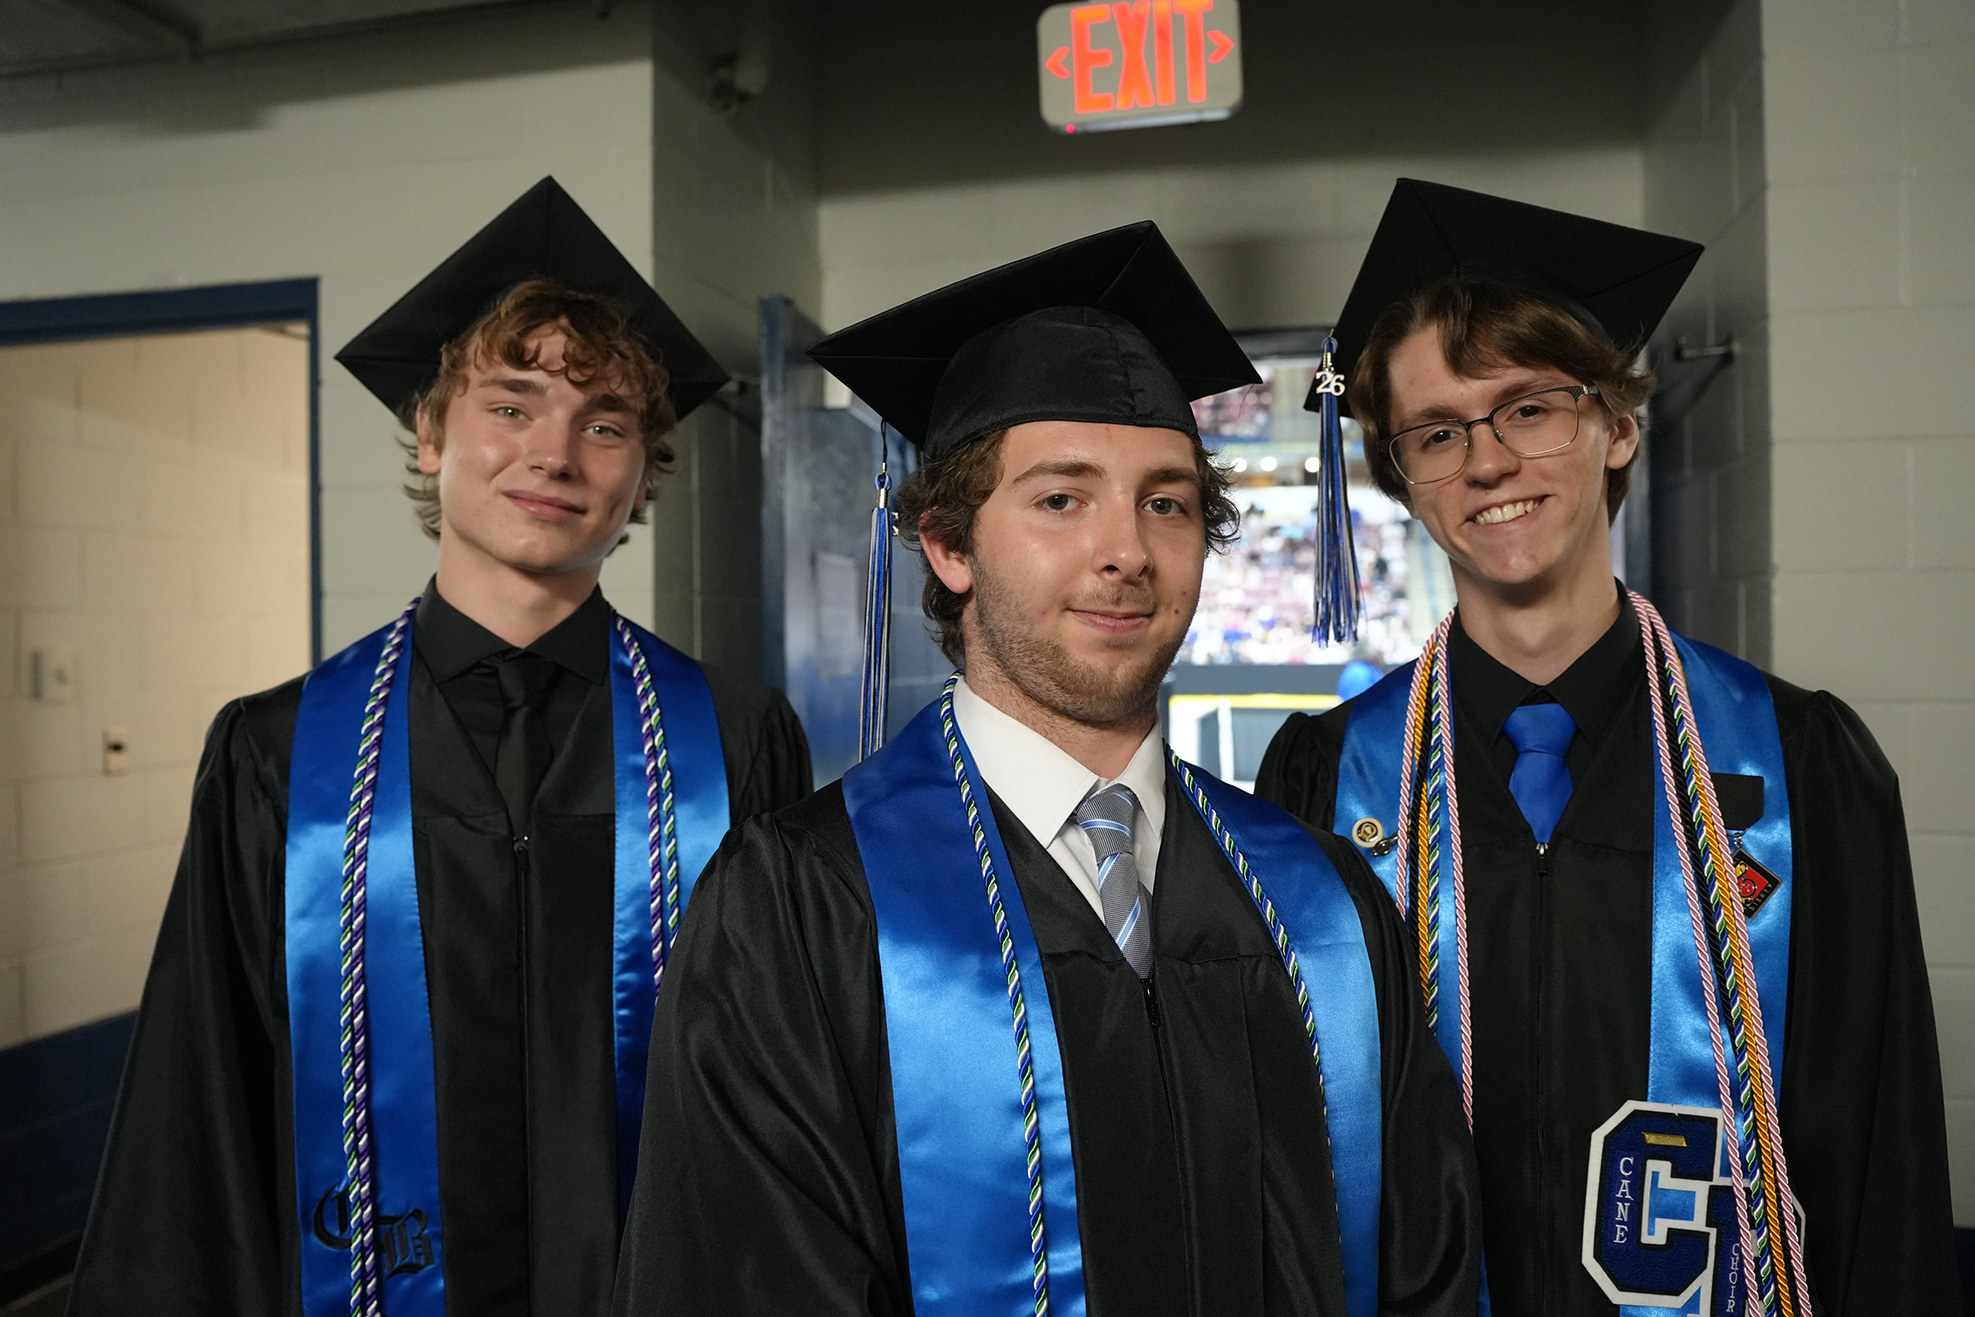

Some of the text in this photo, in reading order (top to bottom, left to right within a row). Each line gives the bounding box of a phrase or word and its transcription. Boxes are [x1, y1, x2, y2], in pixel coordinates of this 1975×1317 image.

[1071, 0, 1214, 114] EXIT
[1315, 371, 1346, 396] 26
[1613, 1156, 1634, 1244] CANE
[1725, 1243, 1740, 1313] CHOIR
